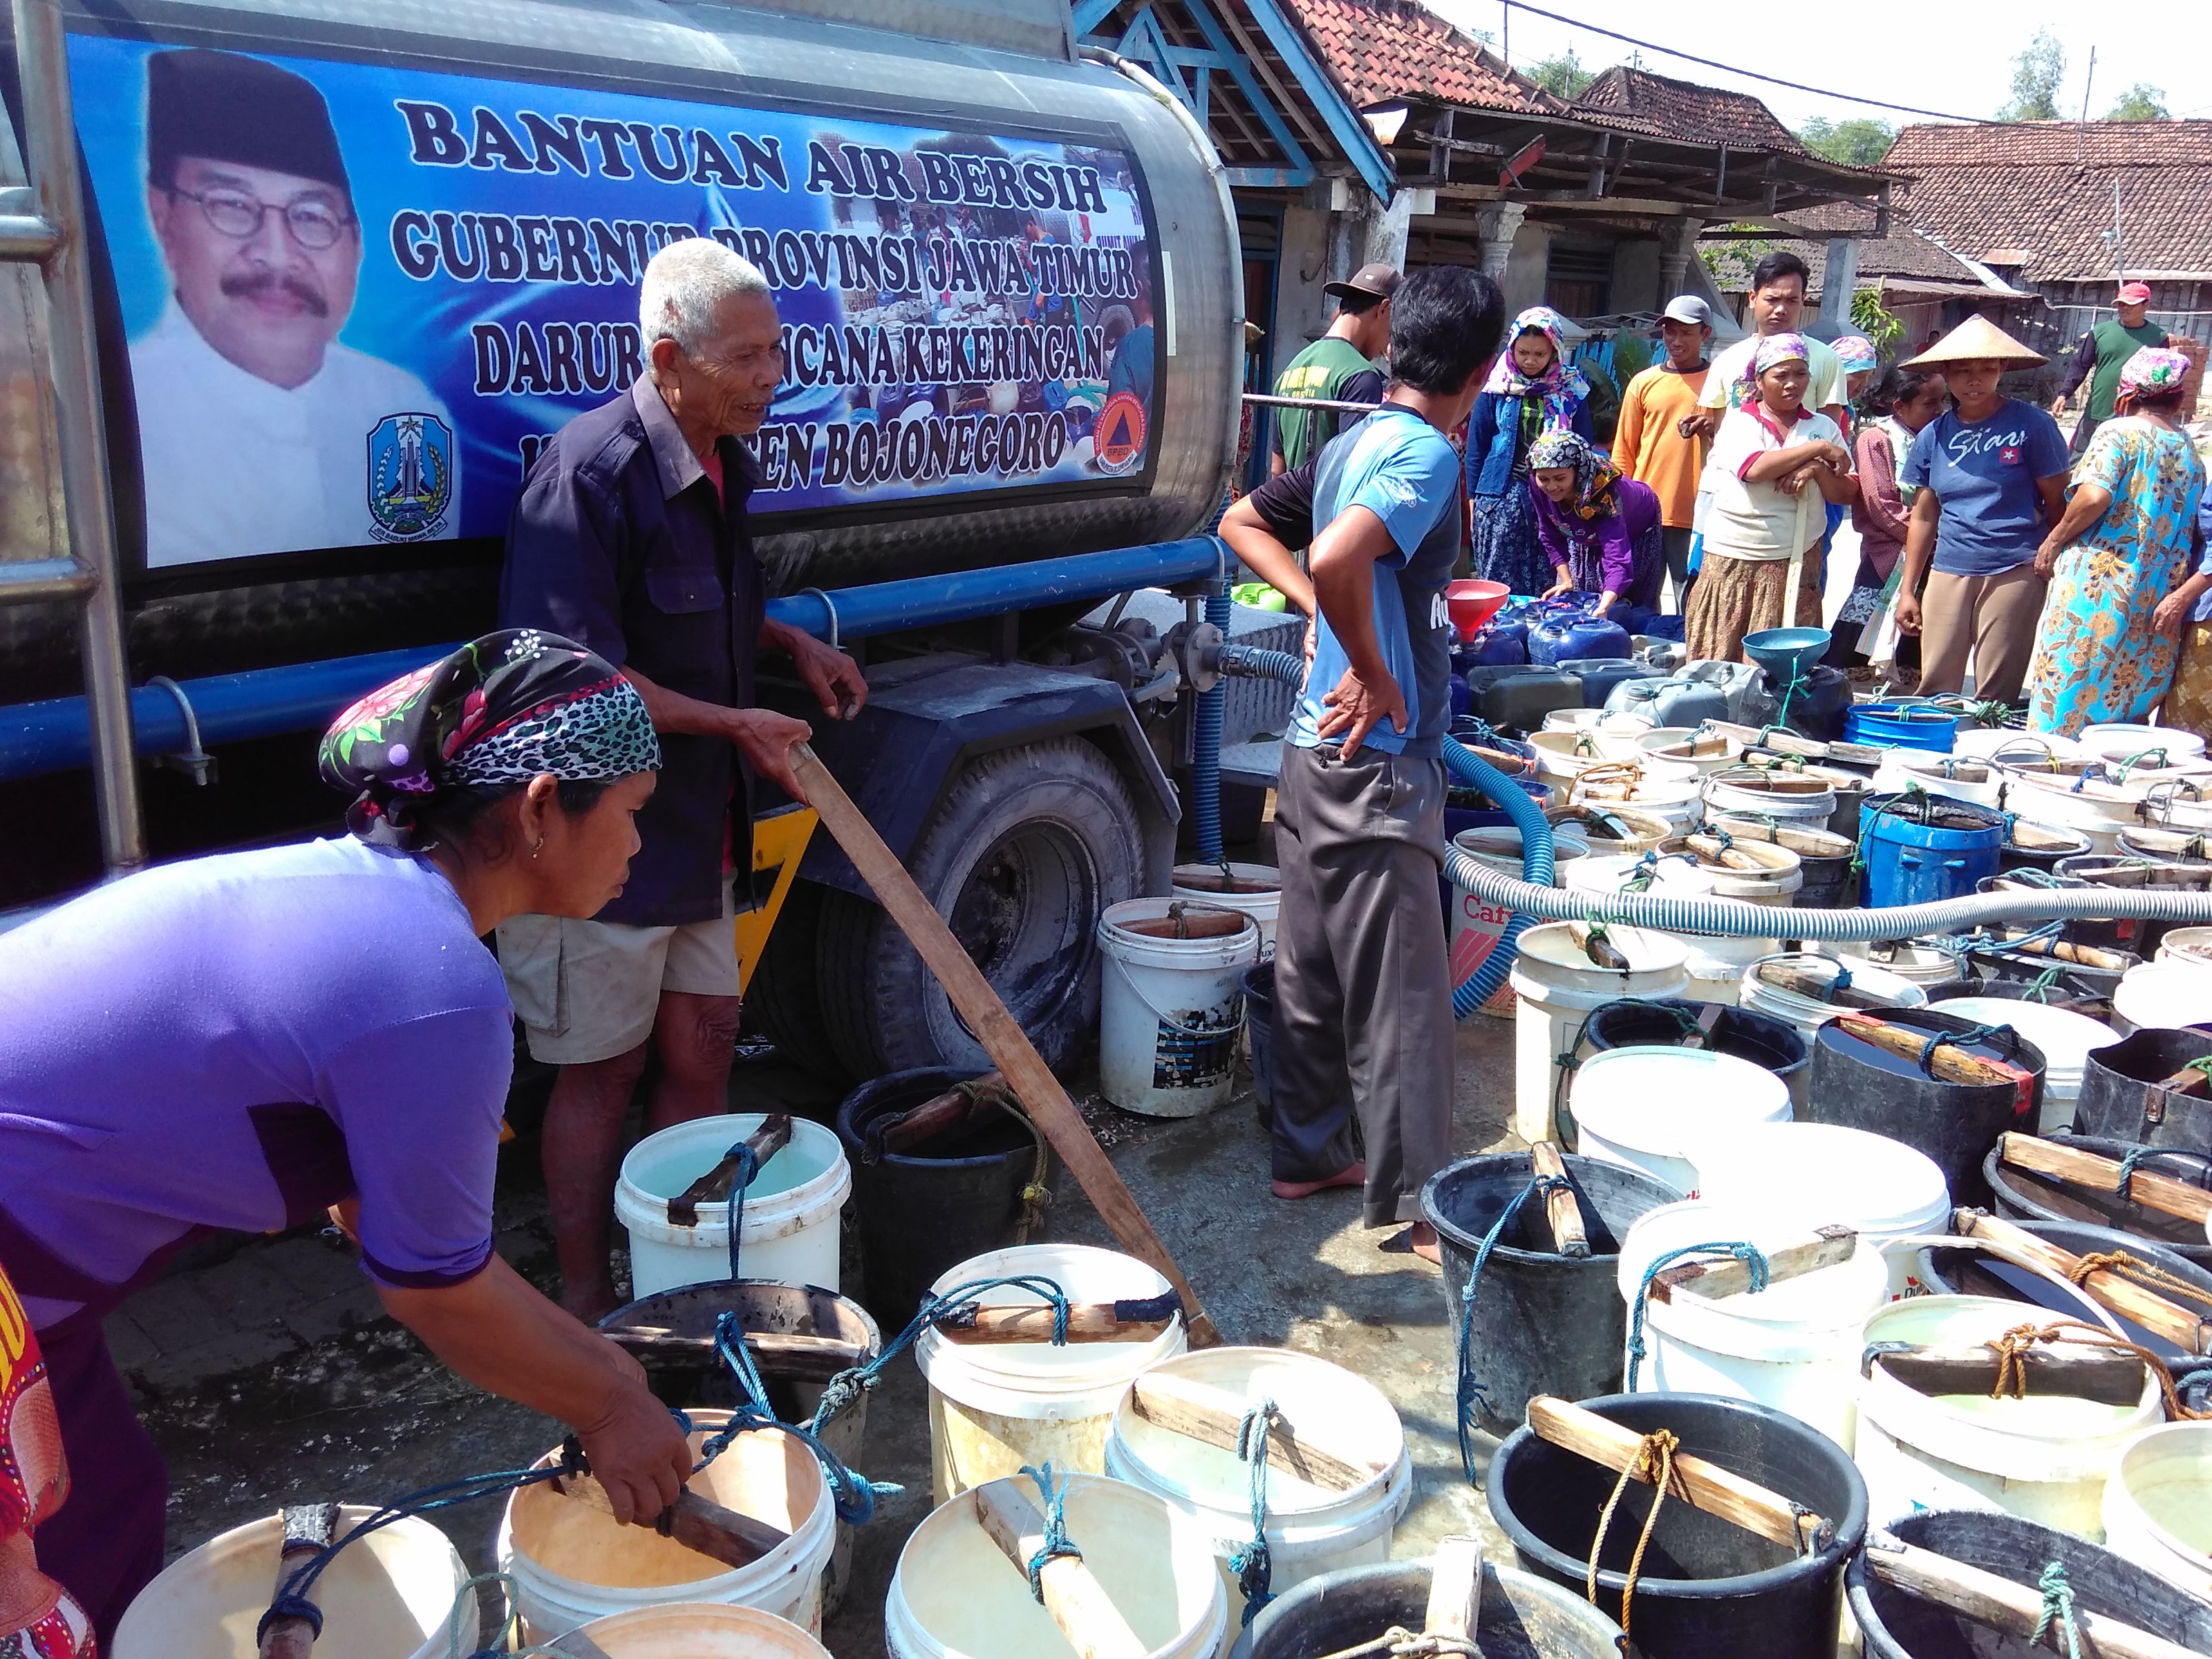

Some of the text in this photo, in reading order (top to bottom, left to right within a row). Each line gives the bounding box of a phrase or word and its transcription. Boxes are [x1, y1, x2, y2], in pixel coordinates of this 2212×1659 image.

[395, 100, 1107, 214] BANTUAN AIR BERSIH
[926, 238, 1031, 297] JAWA
[1033, 244, 1138, 299] TIMUR
[471, 321, 1105, 396] DARUR NCANA KEKERINGAN
[821, 411, 1067, 488] BOJONEGORO
[1107, 447, 1129, 457] BPBD
[409, 532, 427, 541] MAWA
